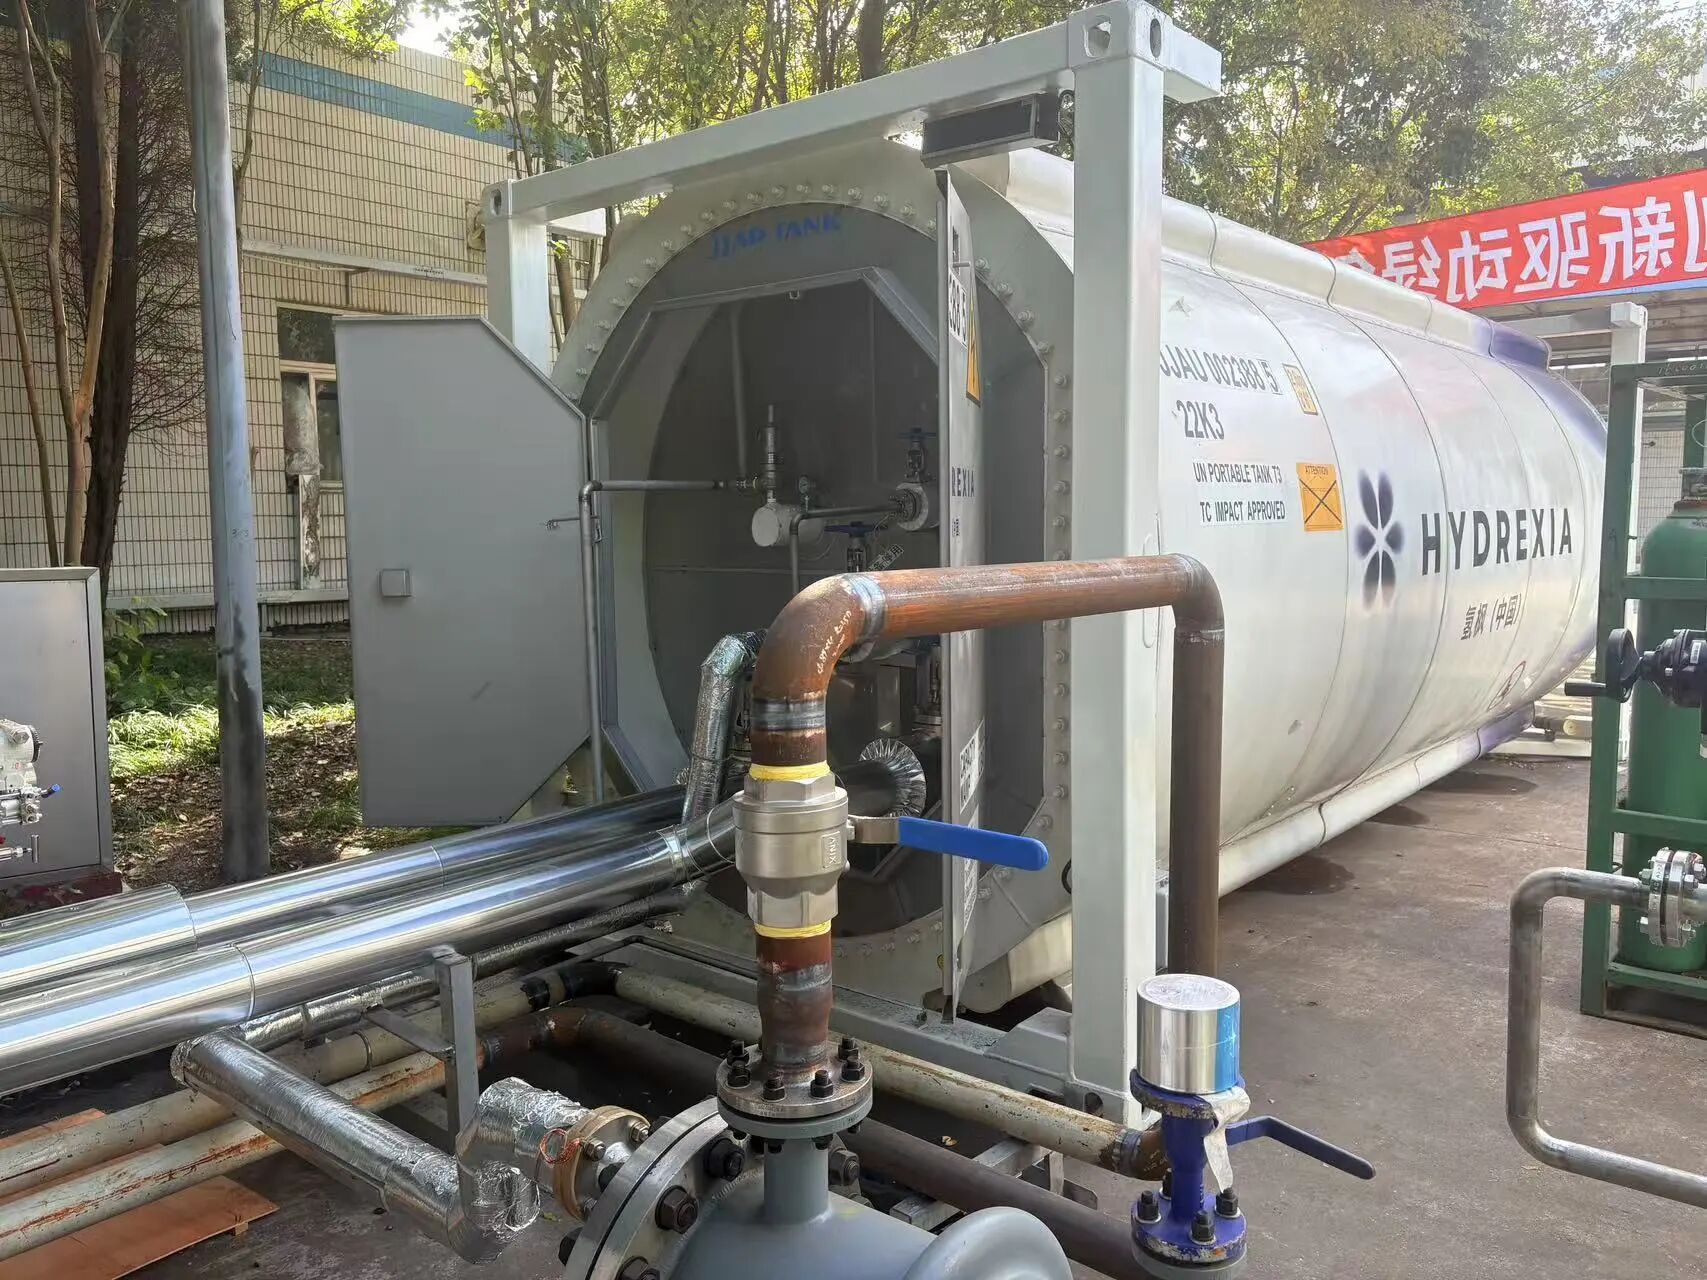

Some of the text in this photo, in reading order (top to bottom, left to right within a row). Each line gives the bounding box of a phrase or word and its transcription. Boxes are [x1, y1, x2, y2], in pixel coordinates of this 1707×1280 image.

[1202, 351, 1267, 392] 002388
[1259, 359, 1280, 394] 5
[1175, 399, 1225, 440] 22K3
[1192, 462, 1283, 484] UN PORTABLE TANK T3
[1200, 500, 1286, 523] TC IMPACT APPROVED
[1421, 507, 1573, 576] HYDREXIA
